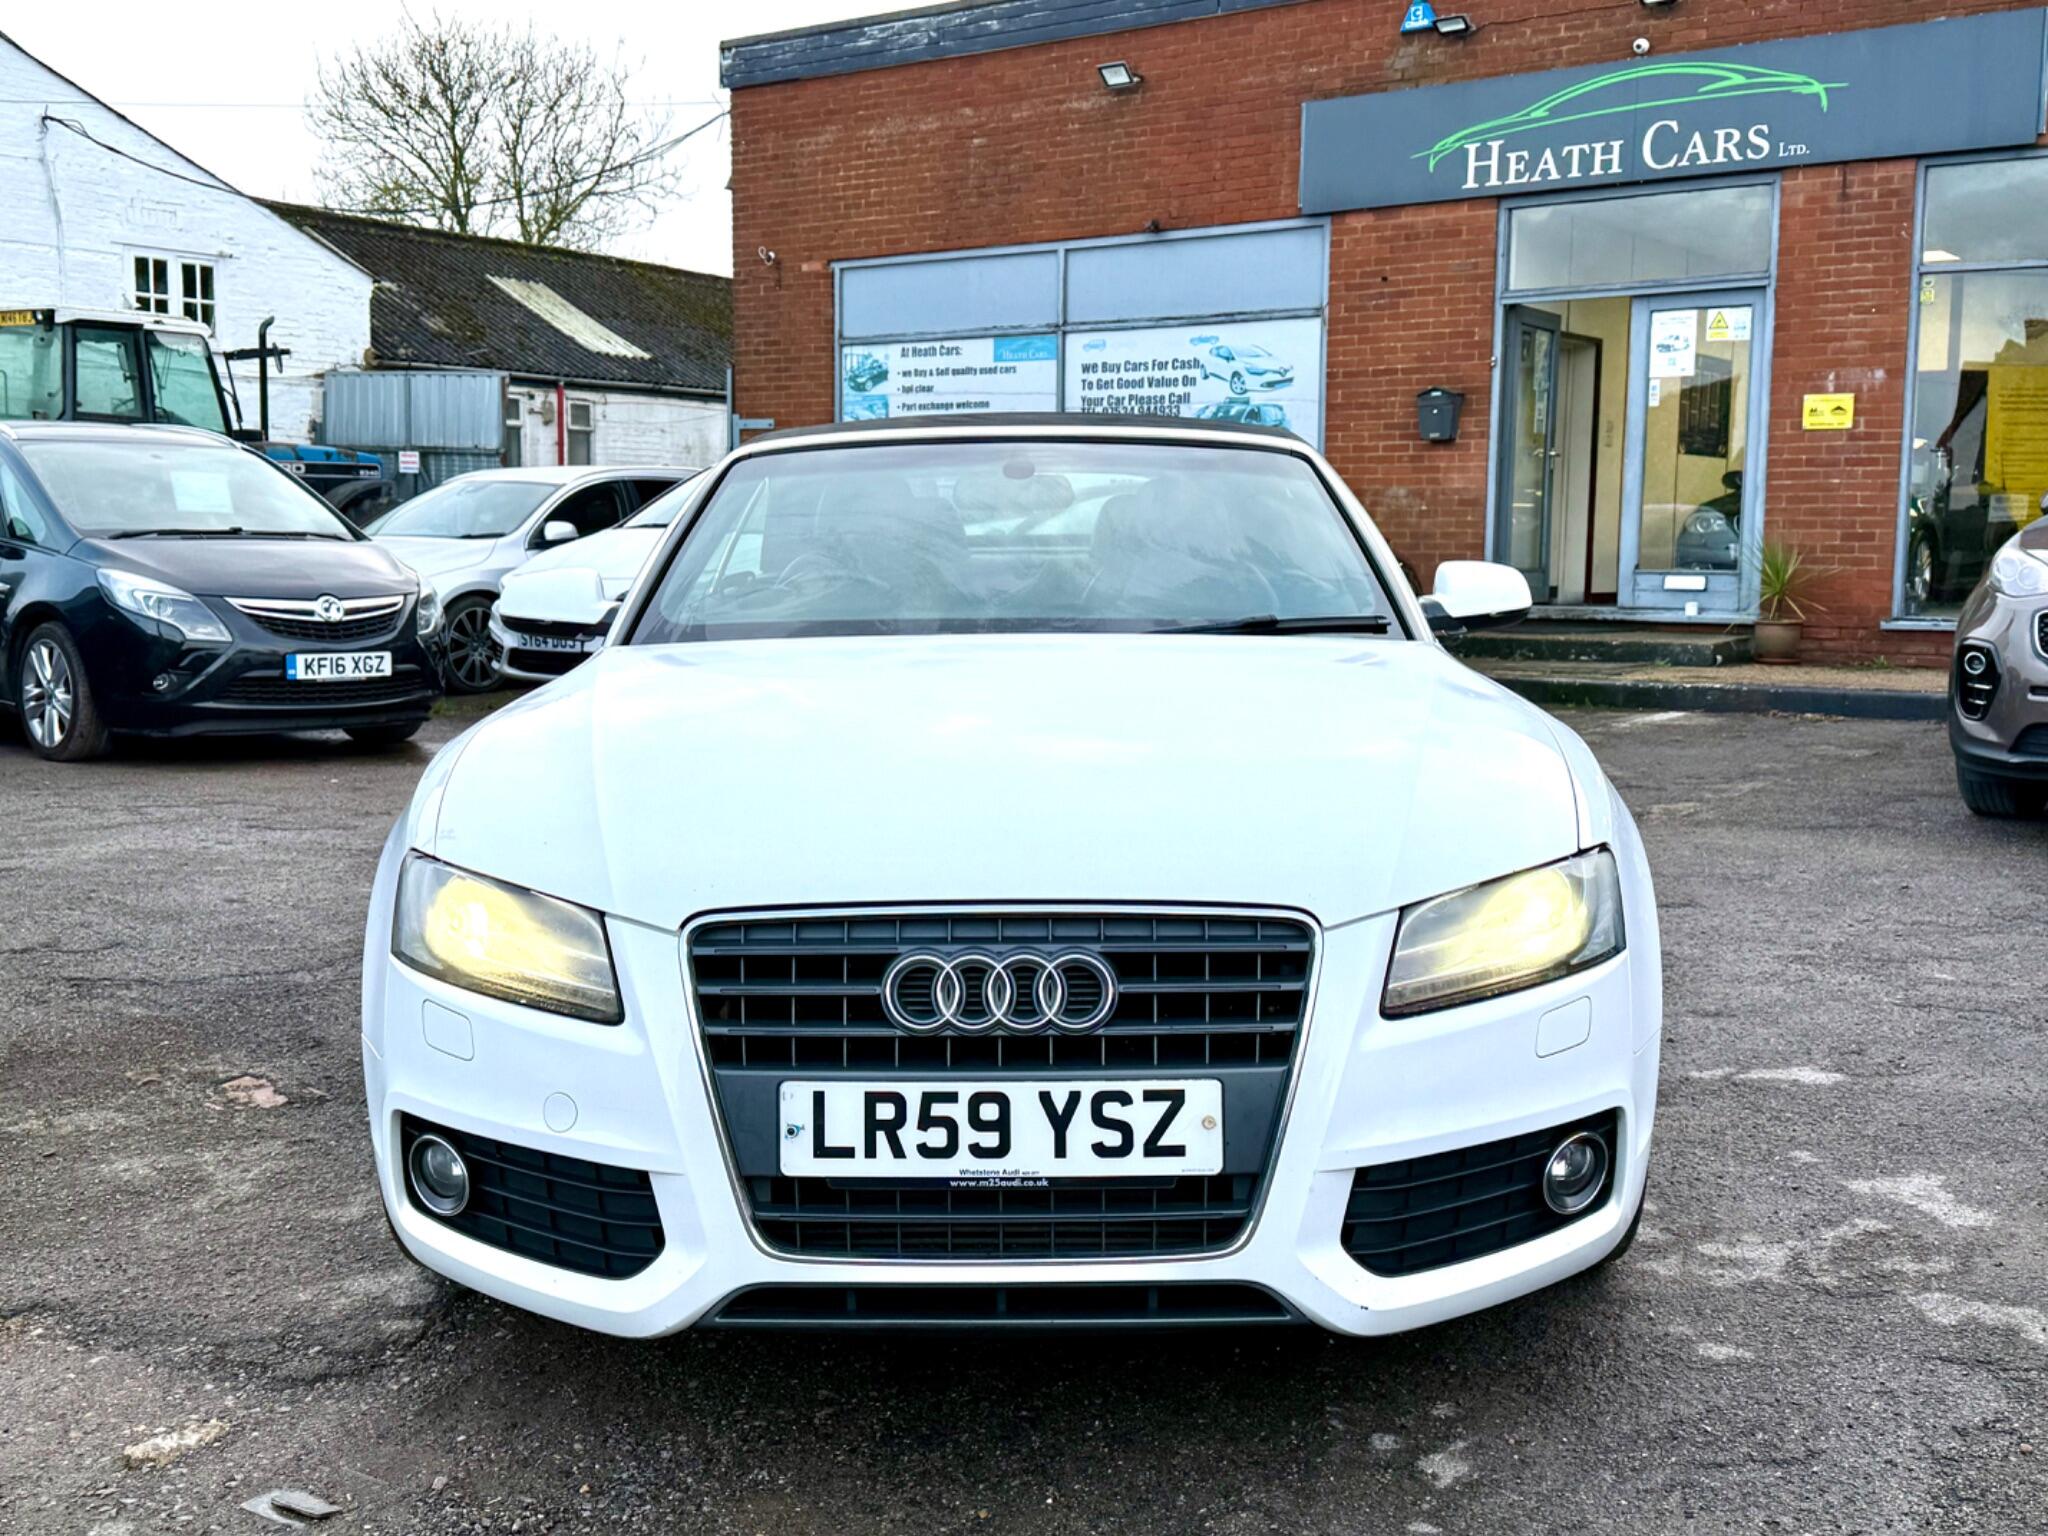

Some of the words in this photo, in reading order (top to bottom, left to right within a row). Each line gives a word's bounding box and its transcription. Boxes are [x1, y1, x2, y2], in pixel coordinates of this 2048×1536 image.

[1461, 139, 1624, 189] HEATH
[1642, 119, 1770, 170] CARS
[912, 345, 936, 358] Heath
[936, 367, 950, 377] Sell
[951, 365, 977, 376] quality
[979, 366, 998, 375] used
[999, 365, 1017, 374] cars
[1101, 360, 1121, 374] Buy
[1124, 359, 1149, 372] Cars
[1151, 358, 1169, 371] For
[915, 384, 934, 393] clear
[1081, 378, 1094, 390] To
[1096, 377, 1115, 390] Get
[1116, 376, 1144, 390] Good
[1147, 375, 1179, 388] Value
[1181, 374, 1197, 387] On
[902, 403, 917, 411] Part
[918, 401, 954, 412] exchange
[956, 399, 990, 409] welcome
[1081, 395, 1104, 407] Your
[1107, 394, 1125, 406] Car
[1128, 392, 1165, 405] Please
[1168, 390, 1190, 405] Call
[304, 656, 346, 675] KF16
[352, 655, 385, 674] XGZ
[813, 1091, 1012, 1159] LR59
[1038, 1089, 1186, 1159] YSZ
[1002, 1168, 1020, 1176] Audi
[950, 1178, 1049, 1187] www.m25audi.co.uk
